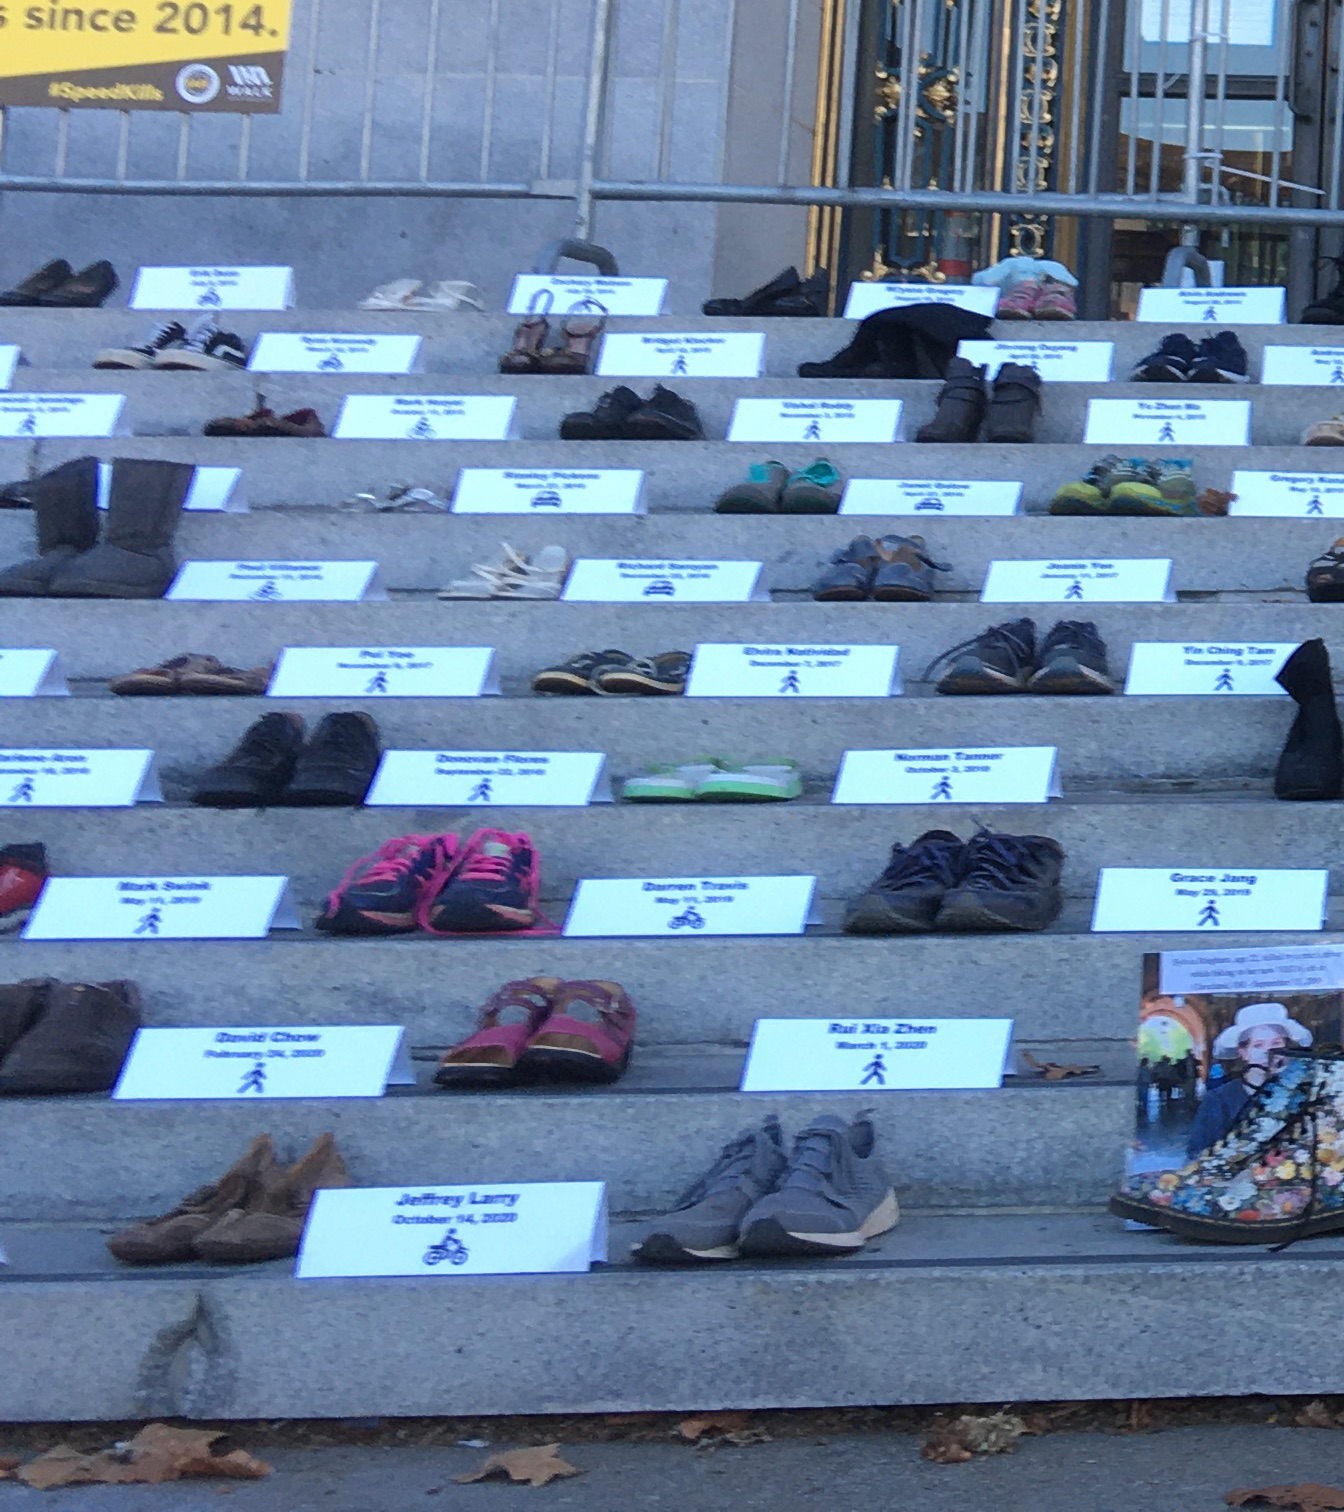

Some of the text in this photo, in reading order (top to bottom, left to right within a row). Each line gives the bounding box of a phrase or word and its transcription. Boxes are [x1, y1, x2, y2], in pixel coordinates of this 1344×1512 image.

[154, 0, 279, 37] 2014.
[1169, 873, 1258, 886] Grace Jang
[1174, 888, 1201, 898] May
[892, 1022, 939, 1035] Zhen
[834, 1040, 879, 1050] March
[394, 1190, 522, 1209] Jeffrey Larry
[391, 1213, 455, 1225] October
